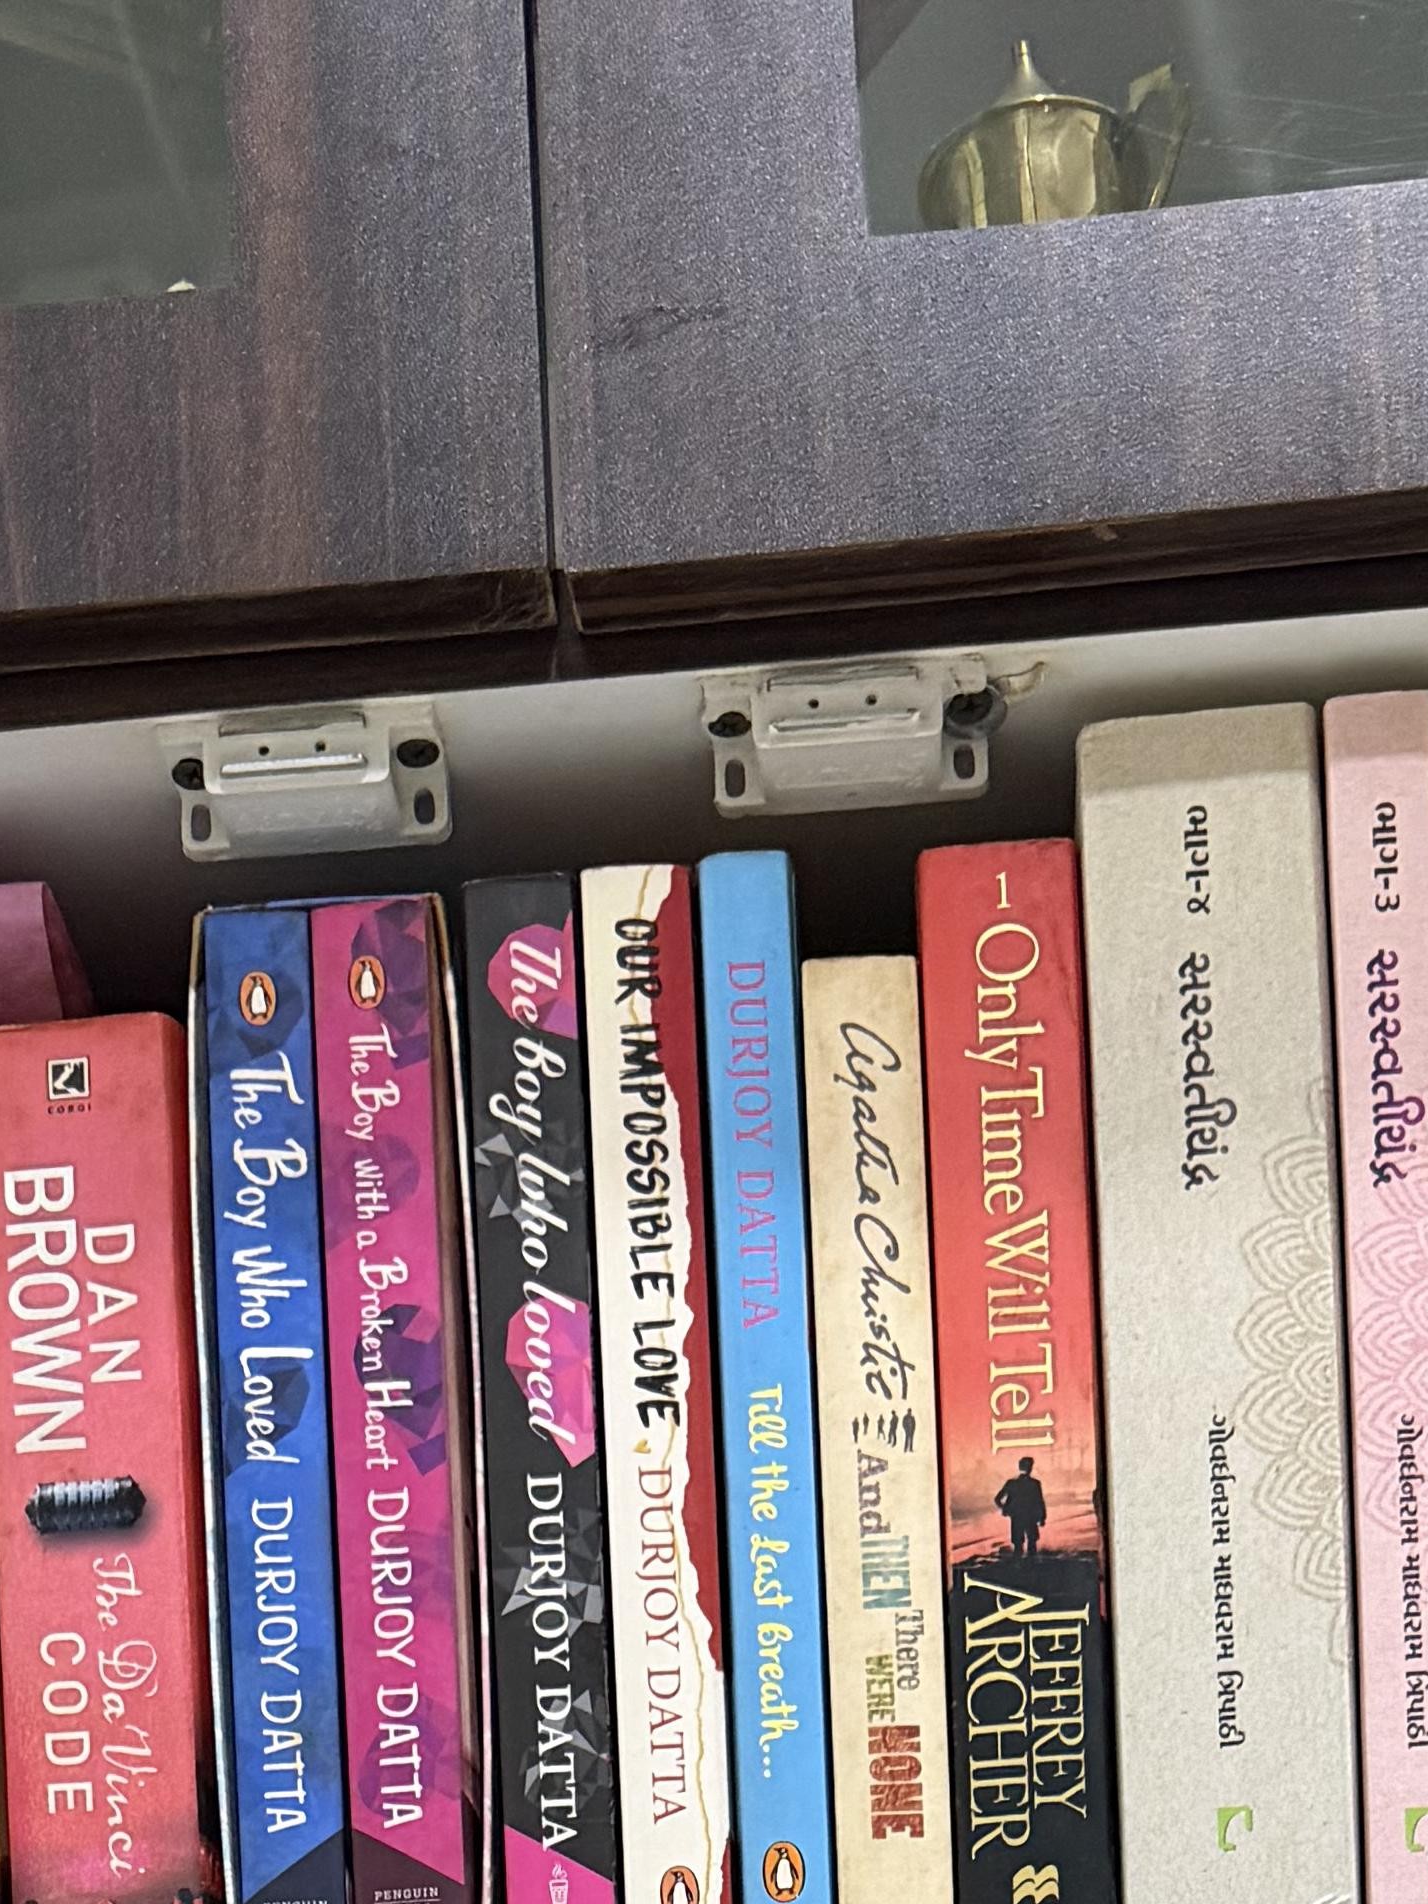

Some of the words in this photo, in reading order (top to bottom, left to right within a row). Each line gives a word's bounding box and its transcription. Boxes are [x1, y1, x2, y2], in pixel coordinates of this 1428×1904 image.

[964, 922, 1045, 1070] Only
[229, 1052, 304, 1128] The
[980, 1065, 1045, 1215] Time
[230, 1137, 303, 1231] Boy
[234, 1244, 310, 1328] Who
[984, 1215, 1050, 1339] Will
[243, 1344, 313, 1466] Loved
[992, 1344, 1053, 1453] Tell
[963, 1575, 1029, 1856] ARCHER
[1024, 1601, 1090, 1819] JEFFREY
